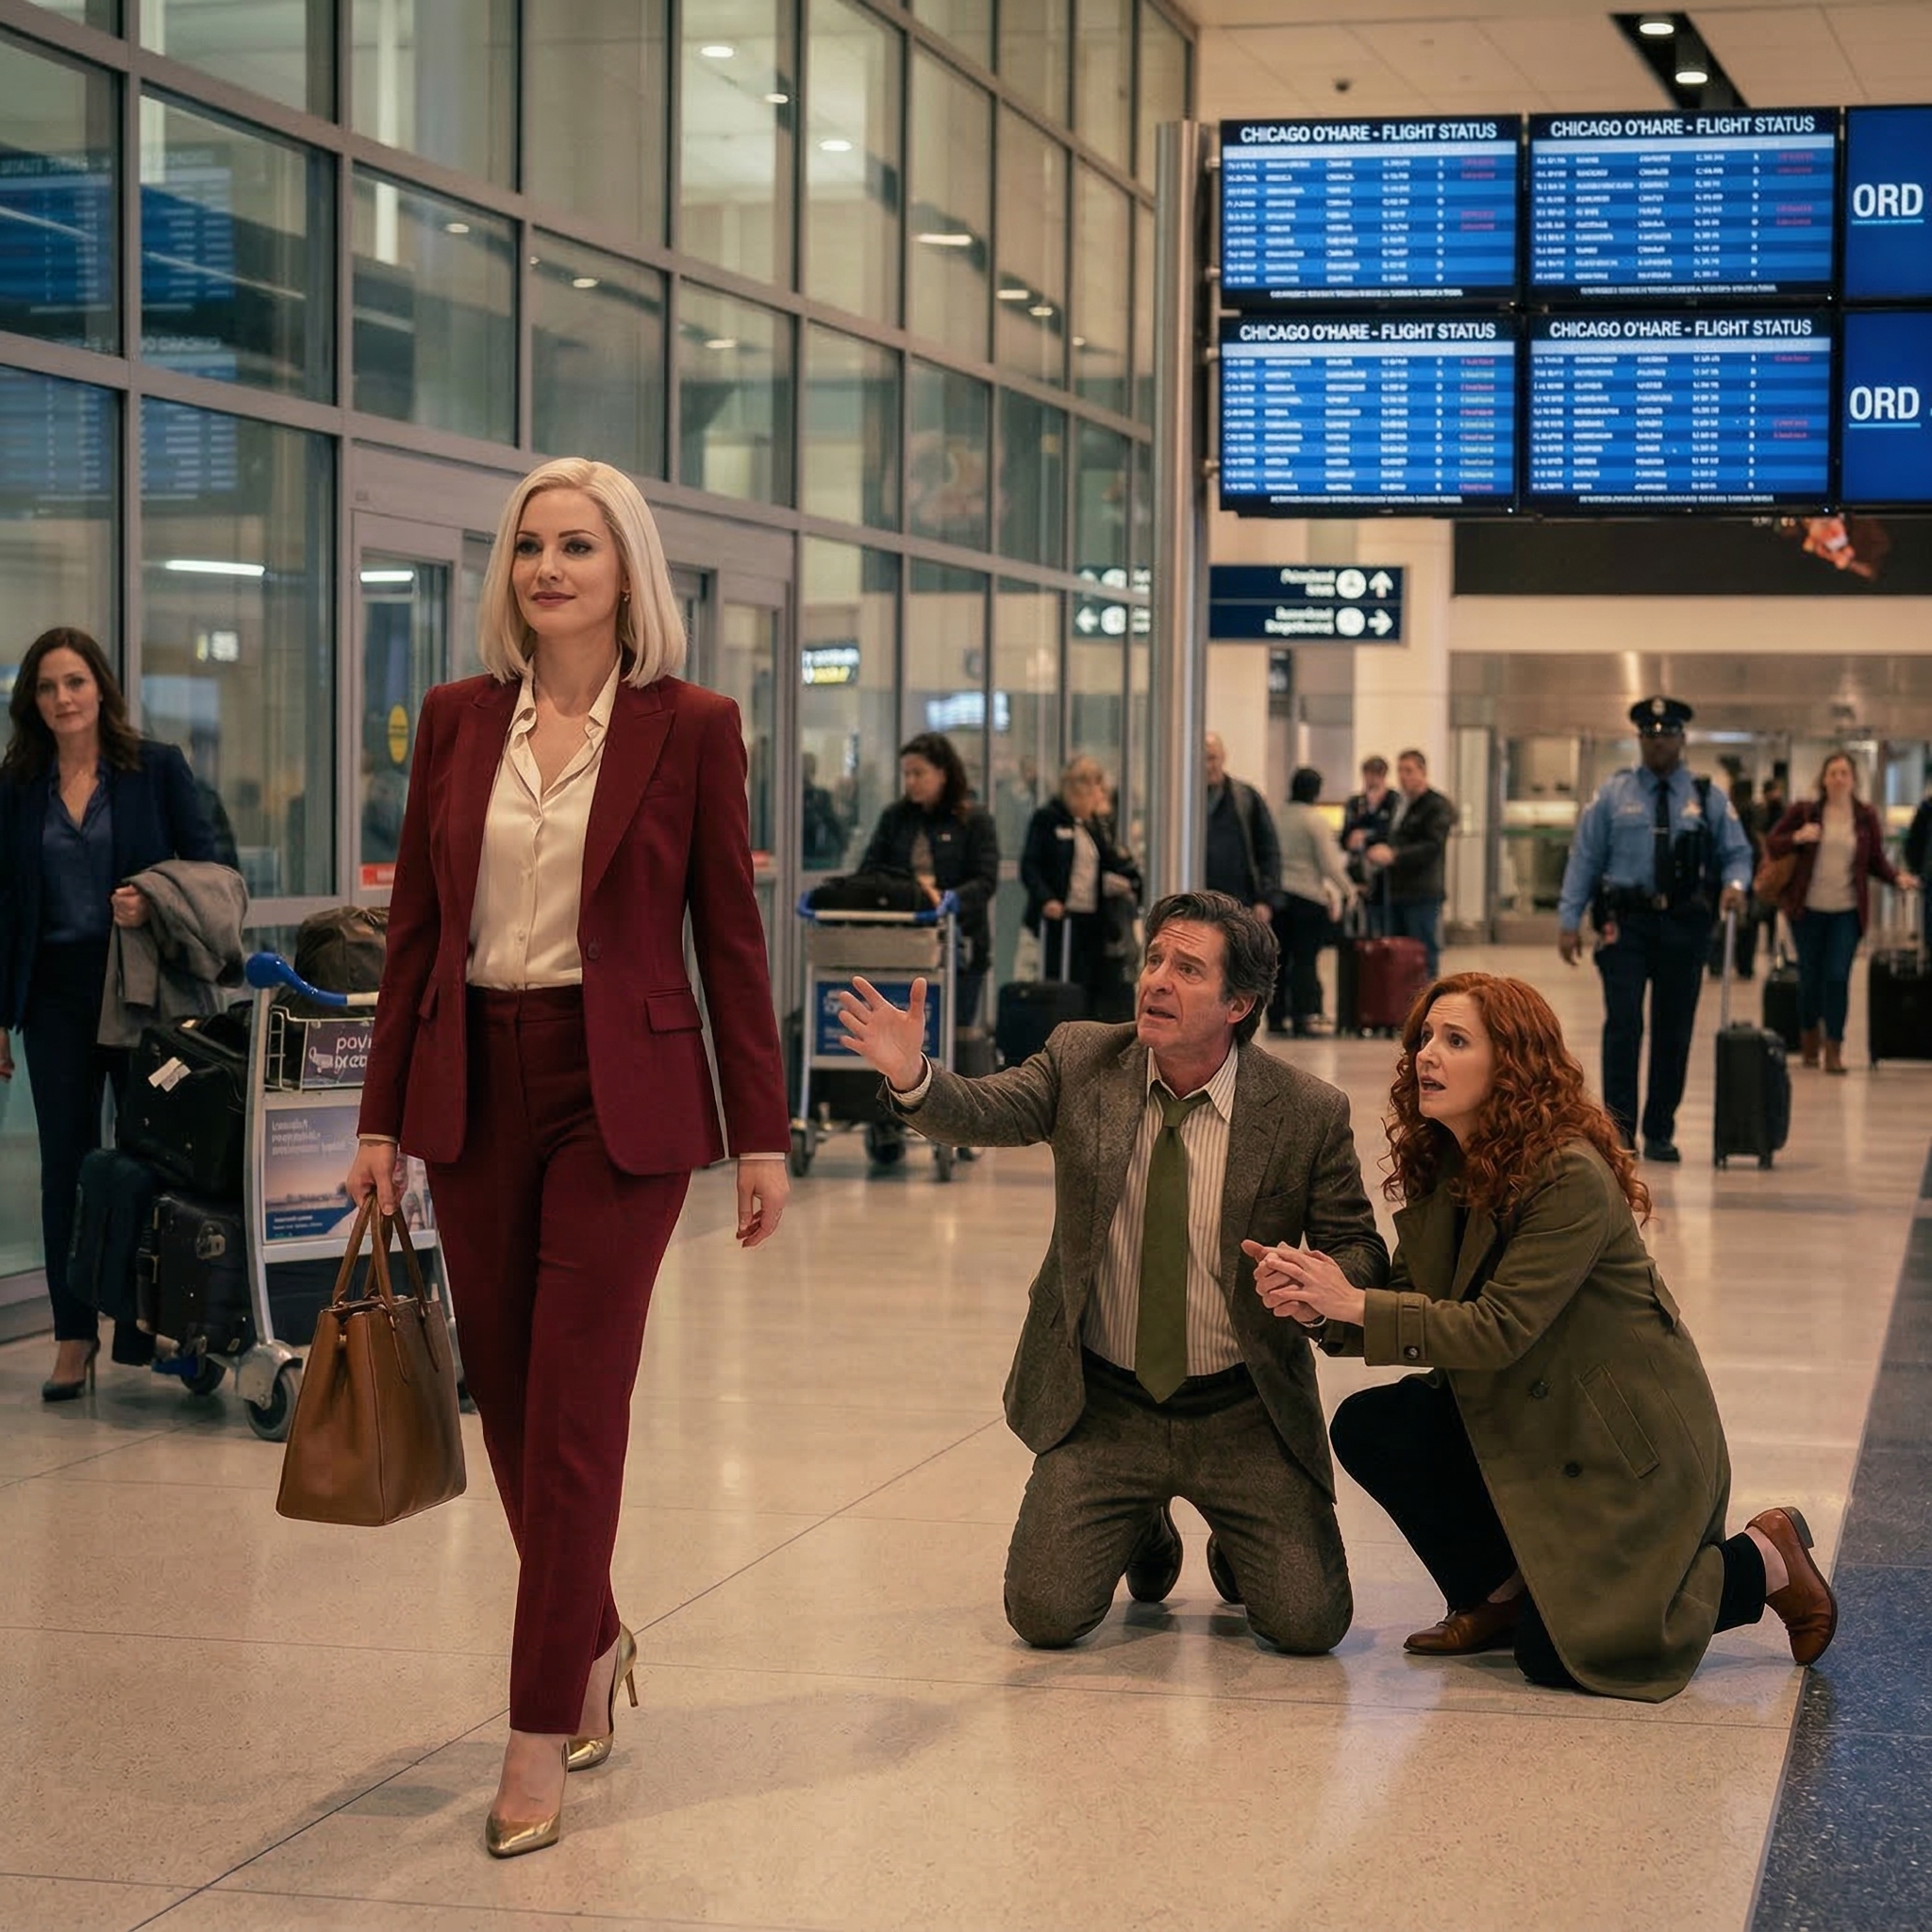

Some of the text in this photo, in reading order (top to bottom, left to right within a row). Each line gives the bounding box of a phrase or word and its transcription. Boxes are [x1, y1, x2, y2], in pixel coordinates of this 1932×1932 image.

[1313, 125, 1370, 142] O'HARE
[1382, 125, 1436, 141] FLIGHT
[1439, 123, 1497, 140] STATUS
[1550, 121, 1622, 138] CHICAGO
[1624, 119, 1684, 136] O'HARE
[1696, 118, 1752, 134] FLIGHT
[1754, 116, 1815, 133] STATUS
[1853, 183, 1924, 217] ORD
[1312, 324, 1370, 341] O'HARE
[1381, 324, 1435, 340] FLIGHT
[1437, 323, 1496, 340] STATUS
[1549, 322, 1621, 338] CHICAGO
[1624, 321, 1682, 337] O'HARE
[1695, 320, 1749, 336] FLIGHT
[1753, 319, 1812, 336] STATUS
[1849, 386, 1920, 420] ORD
